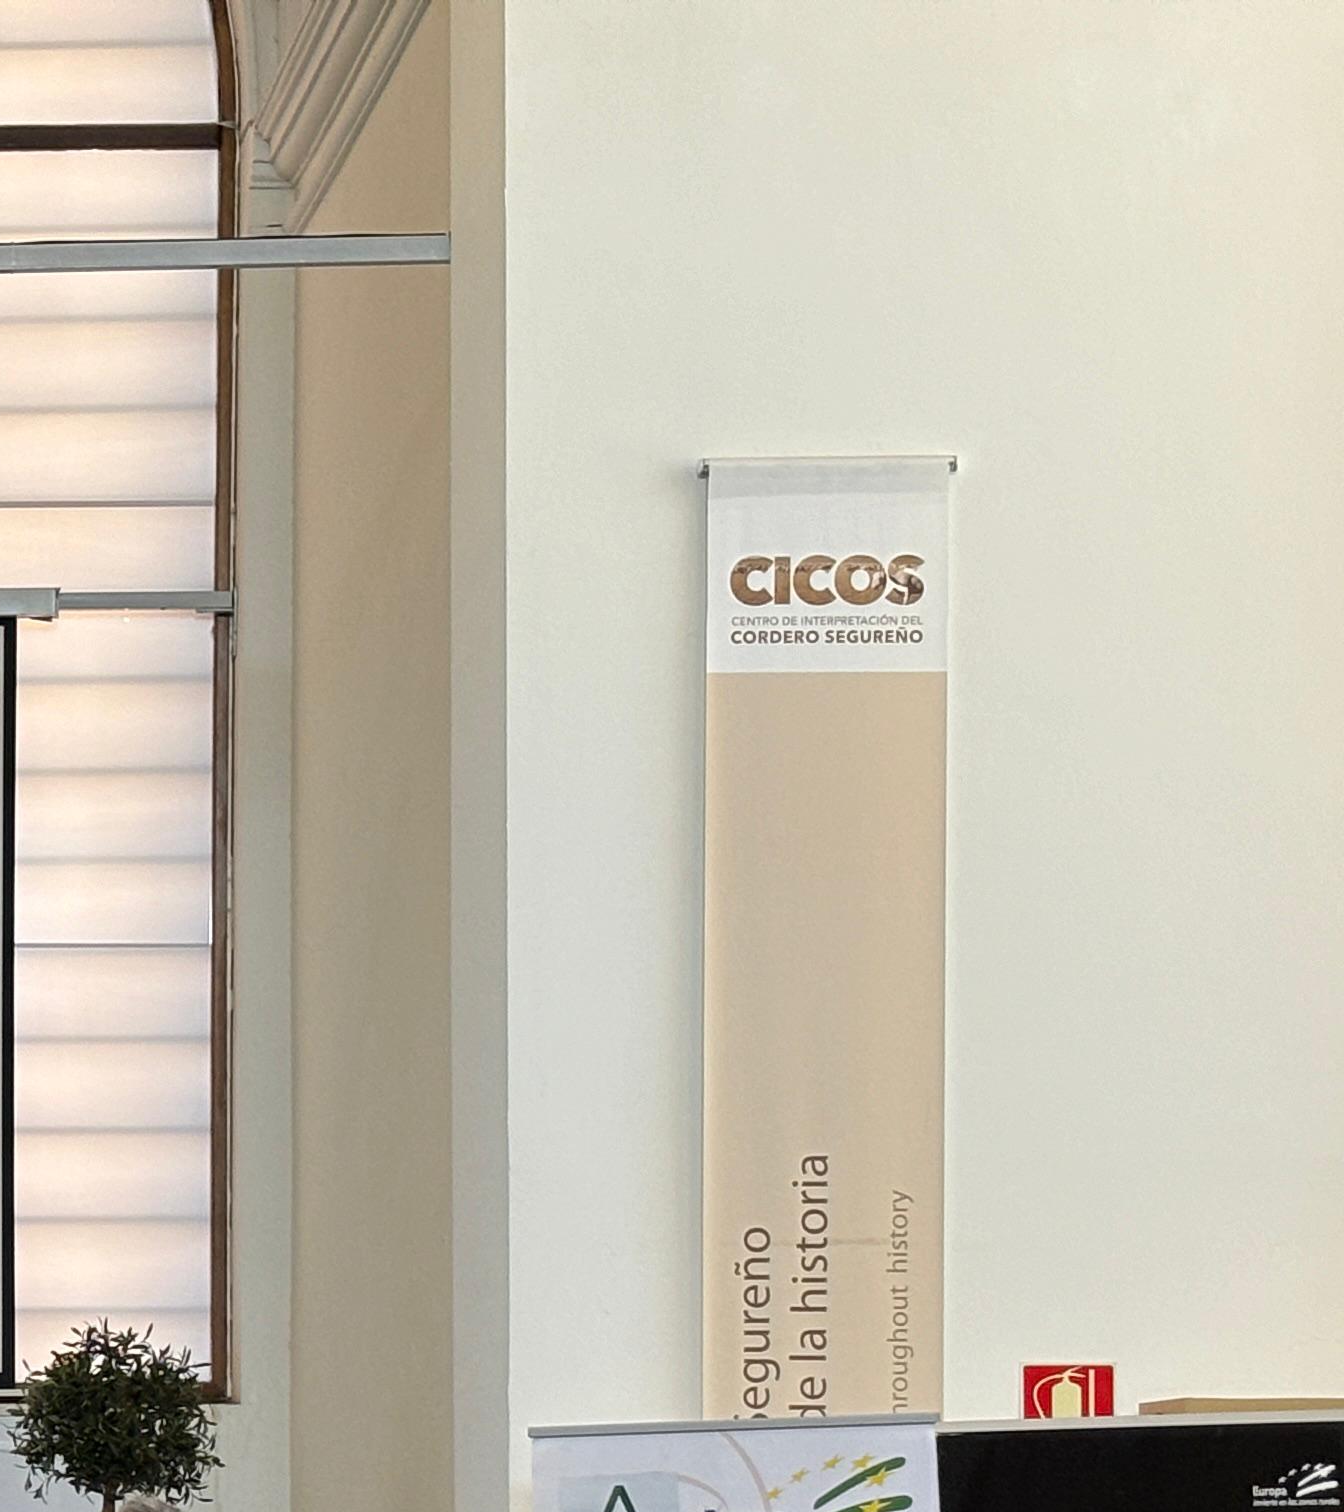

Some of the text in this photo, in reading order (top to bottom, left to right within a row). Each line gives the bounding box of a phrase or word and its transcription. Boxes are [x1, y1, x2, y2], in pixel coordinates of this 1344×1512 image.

[730, 554, 925, 606] CICOS
[731, 614, 924, 626] CENTRO DE INTERPRETACIÓN DEL
[731, 627, 923, 644] CORDERO SEGUREÑO
[789, 1155, 829, 1312] historia
[886, 1189, 914, 1413] hroughout history
[734, 1227, 780, 1419] egureño
[789, 1329, 827, 1361] la
[1253, 1485, 1288, 1498] Europa
